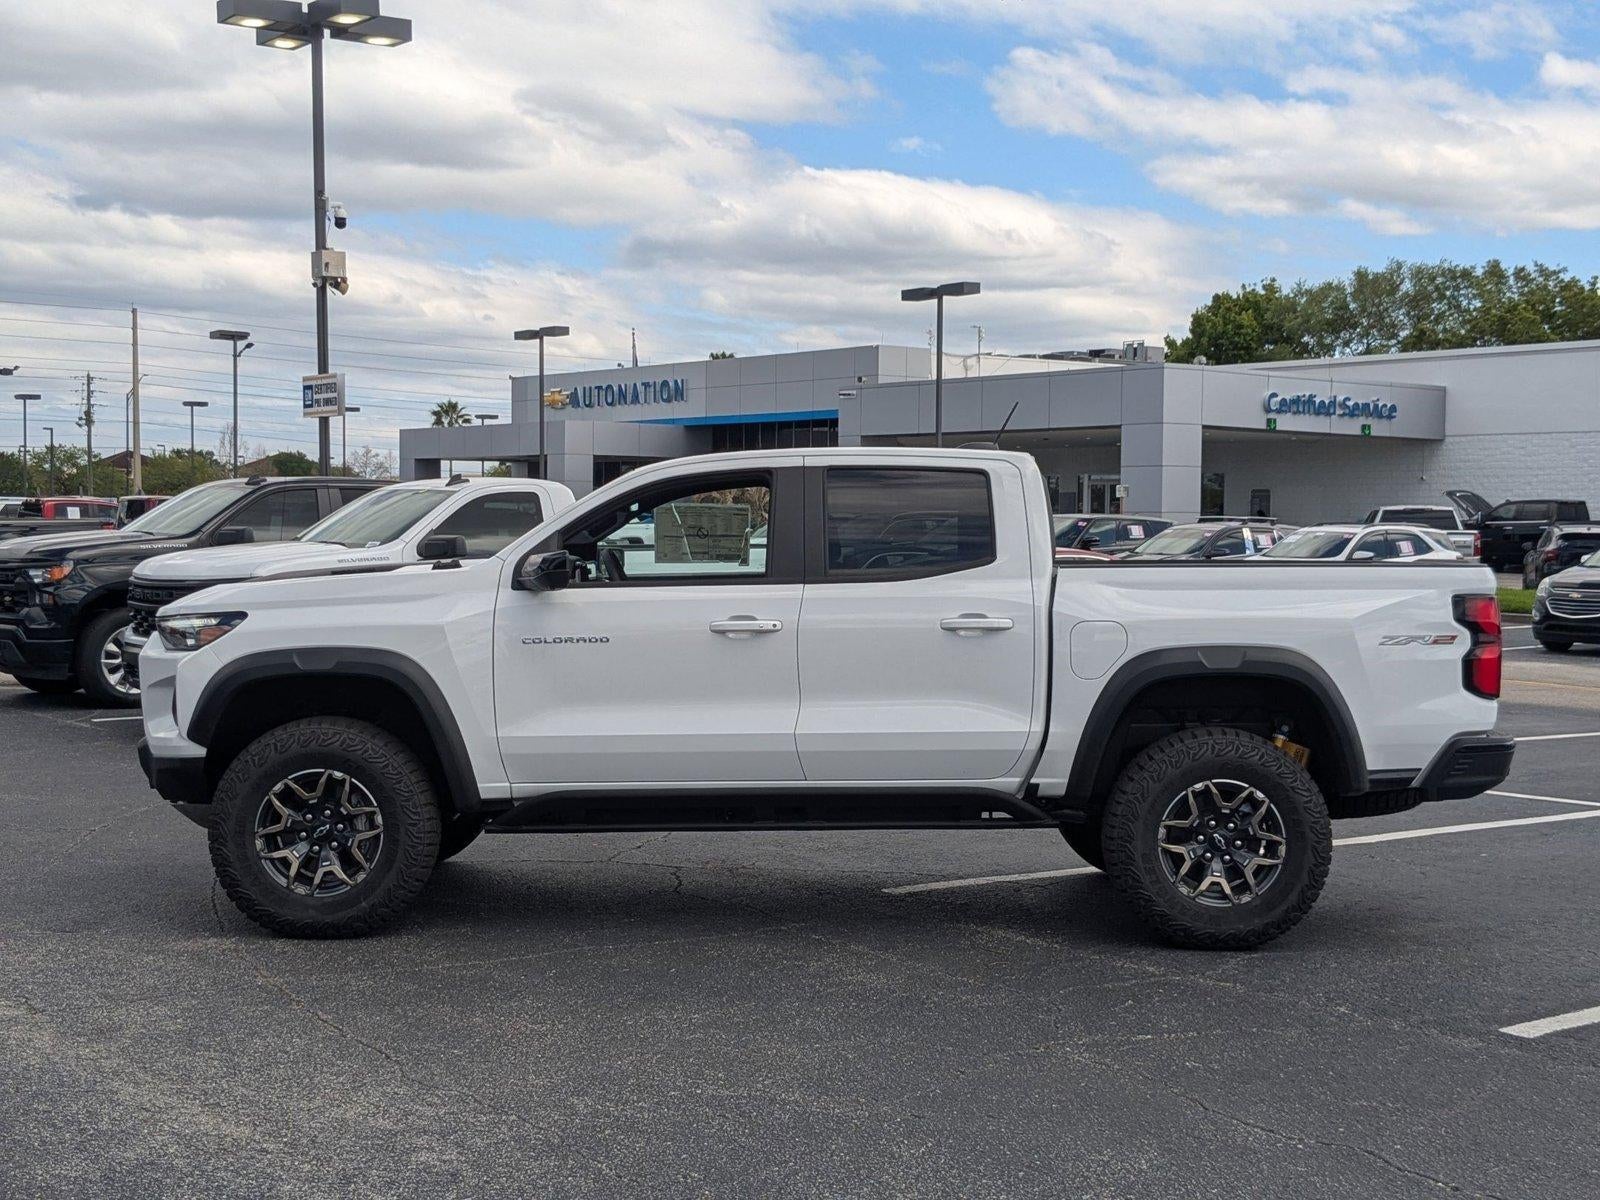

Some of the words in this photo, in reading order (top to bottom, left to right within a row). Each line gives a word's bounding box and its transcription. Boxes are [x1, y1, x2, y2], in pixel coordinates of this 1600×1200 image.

[569, 379, 686, 408] AUTONATION
[1265, 392, 1337, 417] Certified
[1338, 396, 1398, 421] Service
[521, 636, 609, 645] COLORADO
[1378, 634, 1458, 646] ZR2
